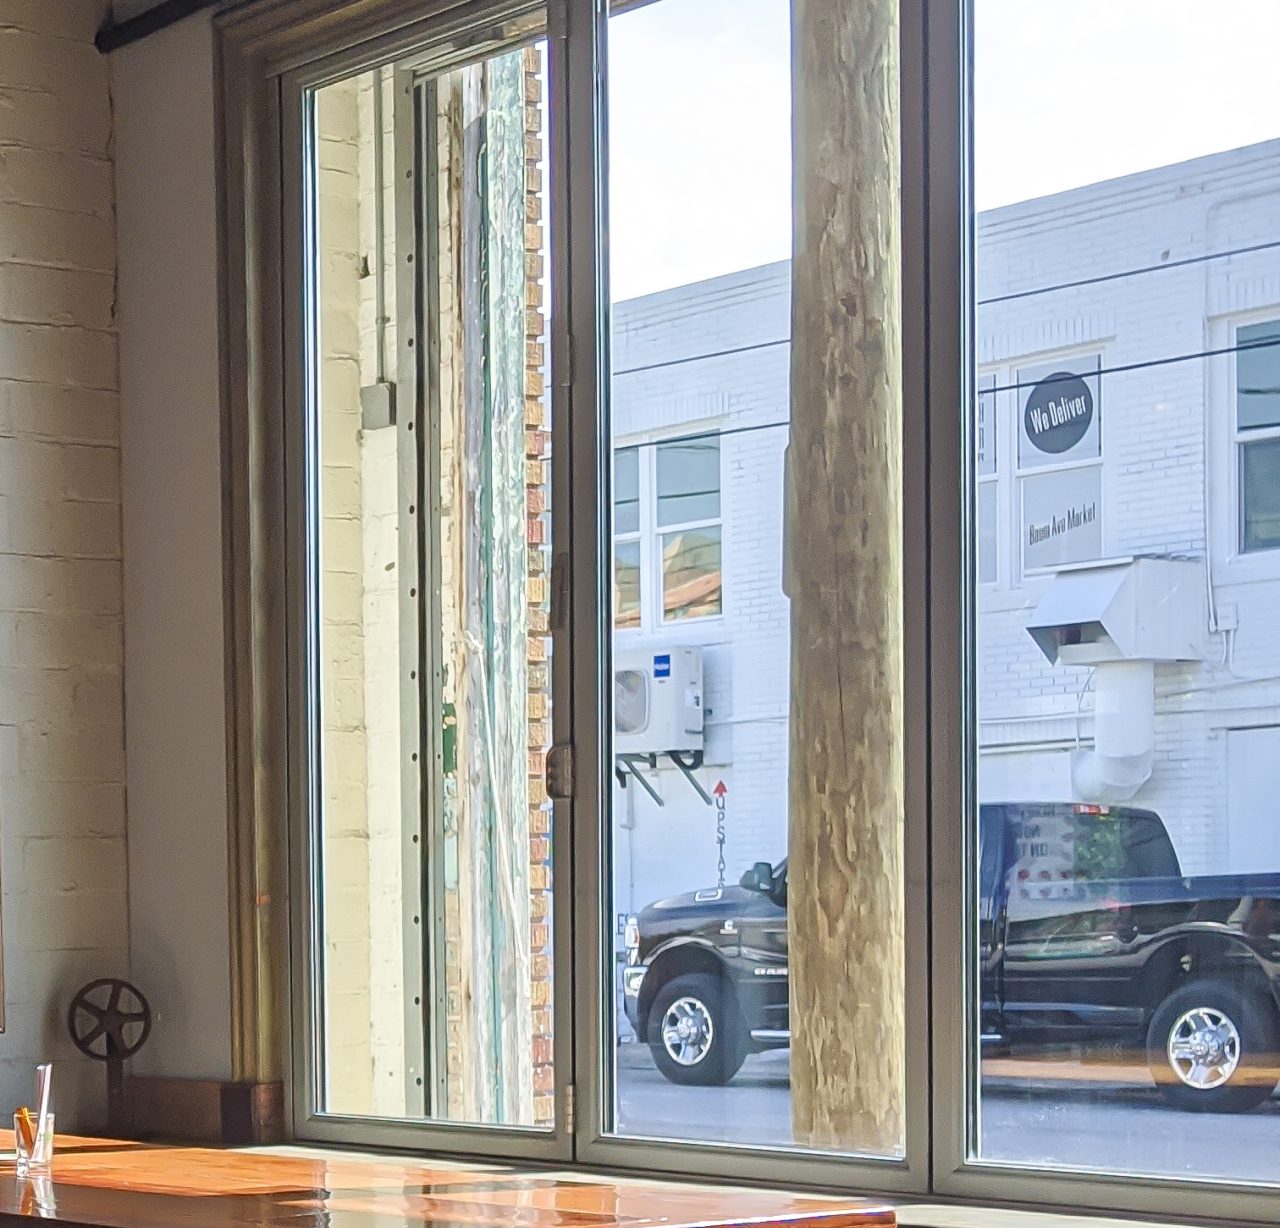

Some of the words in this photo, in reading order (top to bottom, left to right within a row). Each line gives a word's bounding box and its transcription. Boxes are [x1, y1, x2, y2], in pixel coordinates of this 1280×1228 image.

[1030, 407, 1050, 434] We
[1049, 395, 1087, 427] Deliver
[1067, 501, 1096, 530] Market
